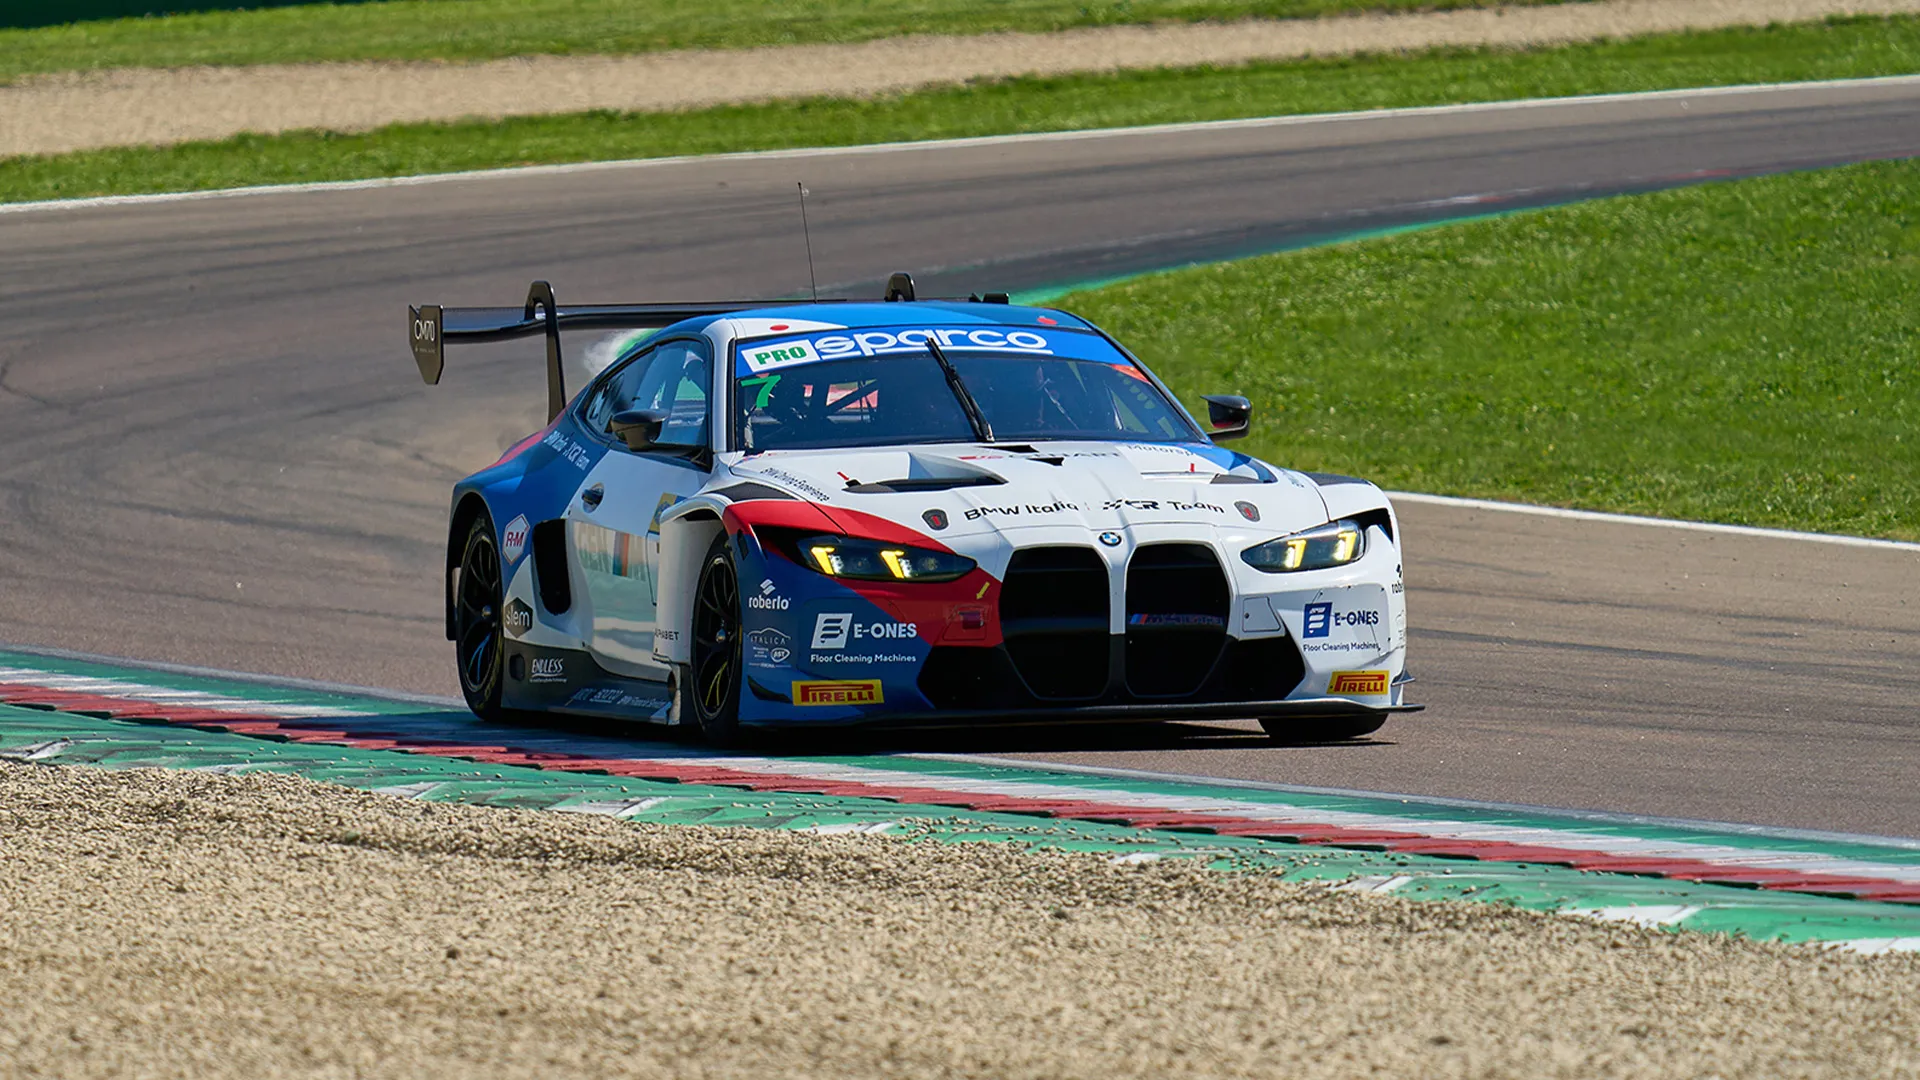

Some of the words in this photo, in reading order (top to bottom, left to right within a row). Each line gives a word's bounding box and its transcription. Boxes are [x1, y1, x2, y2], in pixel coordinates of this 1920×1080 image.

[814, 329, 1048, 356] sparco
[754, 346, 807, 365] PRO
[741, 375, 781, 408] 7
[964, 504, 1019, 521] BMW
[1026, 501, 1080, 515] Italia
[1166, 501, 1226, 514] Team
[748, 594, 789, 610] roberlo
[1334, 610, 1379, 627] E-ONES
[854, 622, 917, 639] E-ONES
[1303, 643, 1320, 652] Floor
[1322, 641, 1350, 652] Cleaning
[1350, 641, 1379, 650] Machines
[810, 653, 833, 663] Floor
[834, 653, 873, 665] Cleaning
[874, 653, 917, 663] Machines
[1333, 674, 1385, 692] PIRELLI
[799, 683, 875, 703] PIRELLI
